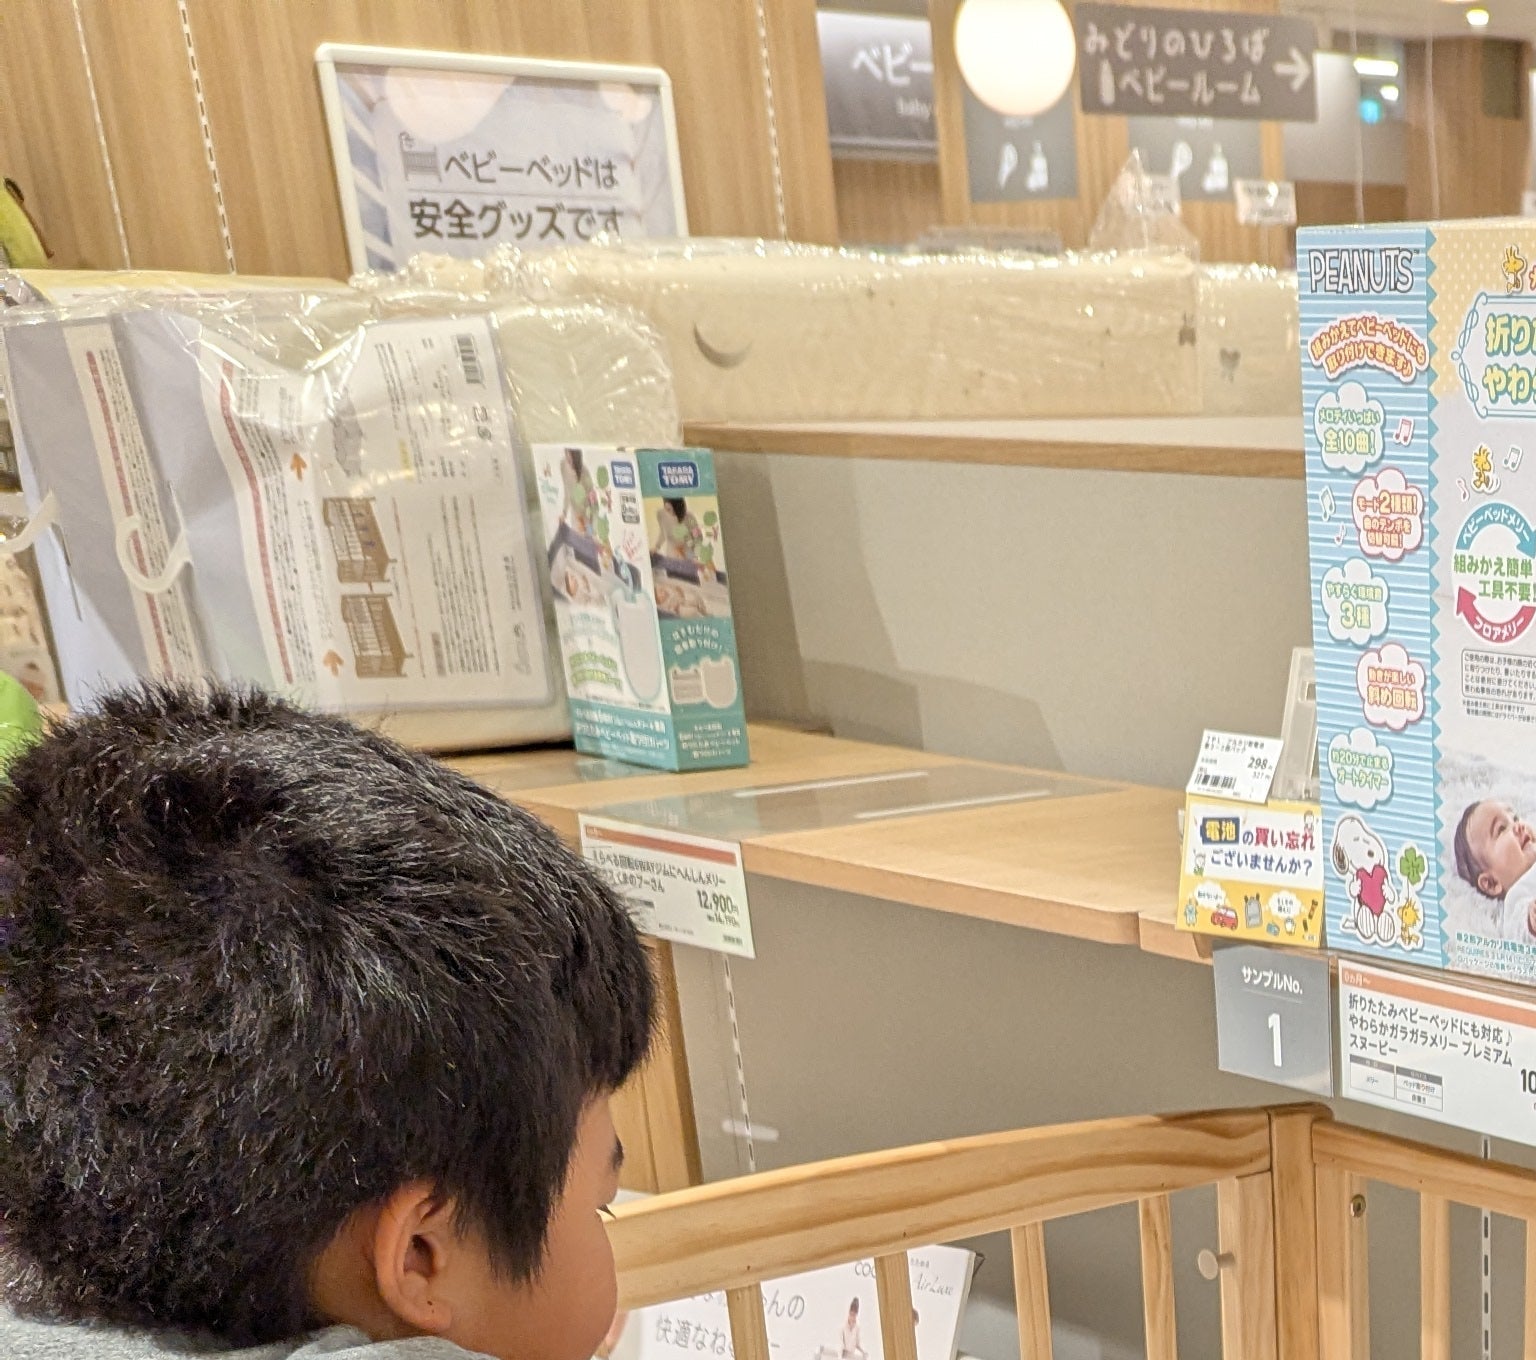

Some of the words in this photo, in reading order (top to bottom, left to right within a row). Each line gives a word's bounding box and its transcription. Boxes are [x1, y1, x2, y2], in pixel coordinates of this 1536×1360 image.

[1084, 22, 1269, 64] みどりのひろば
[1118, 69, 1262, 104] ベビールーム
[444, 150, 620, 190] ベビーベッドは
[1308, 247, 1414, 294] PEANUTS
[1323, 427, 1377, 456] 全10曲!
[1453, 554, 1534, 579] 組みかえ簡単
[1340, 600, 1372, 630] 3種
[1473, 615, 1525, 641] フロアメリー
[1366, 685, 1419, 712] 斜め回転
[1337, 766, 1389, 792] オートタイマー
[1205, 820, 1315, 851] 電池の買い忘れ
[1211, 850, 1313, 876] ございませんか?
[1241, 965, 1304, 997] サンプルNo.
[1267, 1012, 1283, 1068] 1
[1349, 1013, 1459, 1051] やわらかガラガラメリー
[1461, 1039, 1513, 1068] プレミアム
[1349, 1033, 1398, 1057] スヌーピー
